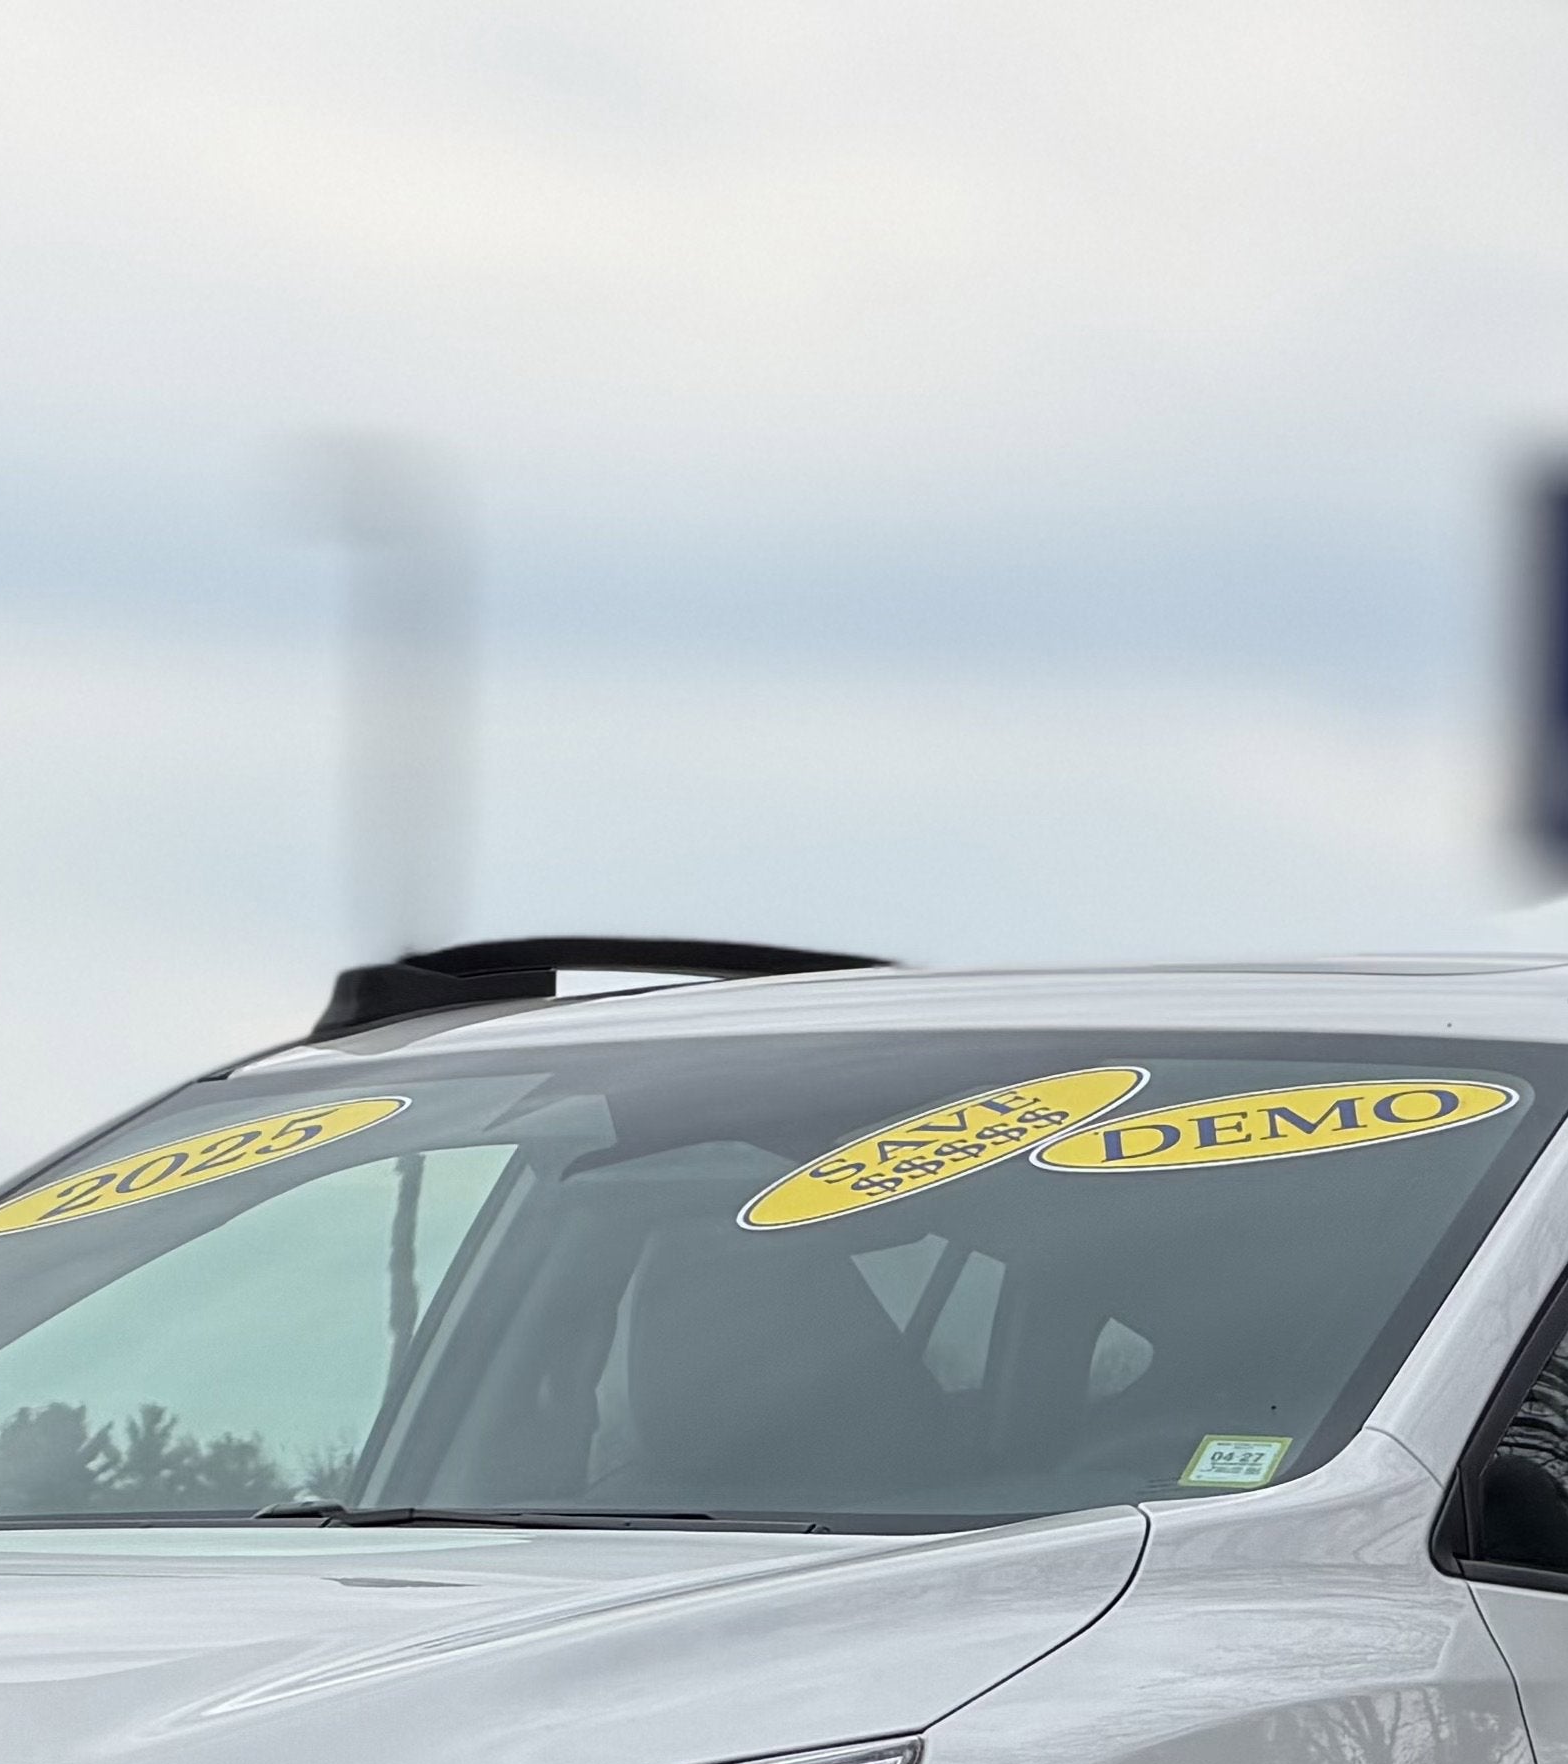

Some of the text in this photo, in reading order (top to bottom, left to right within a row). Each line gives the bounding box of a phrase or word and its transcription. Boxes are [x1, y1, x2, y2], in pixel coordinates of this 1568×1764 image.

[35, 1107, 340, 1222] 2025
[809, 1089, 1045, 1187] SAVE
[1098, 1088, 1460, 1164] DEMO
